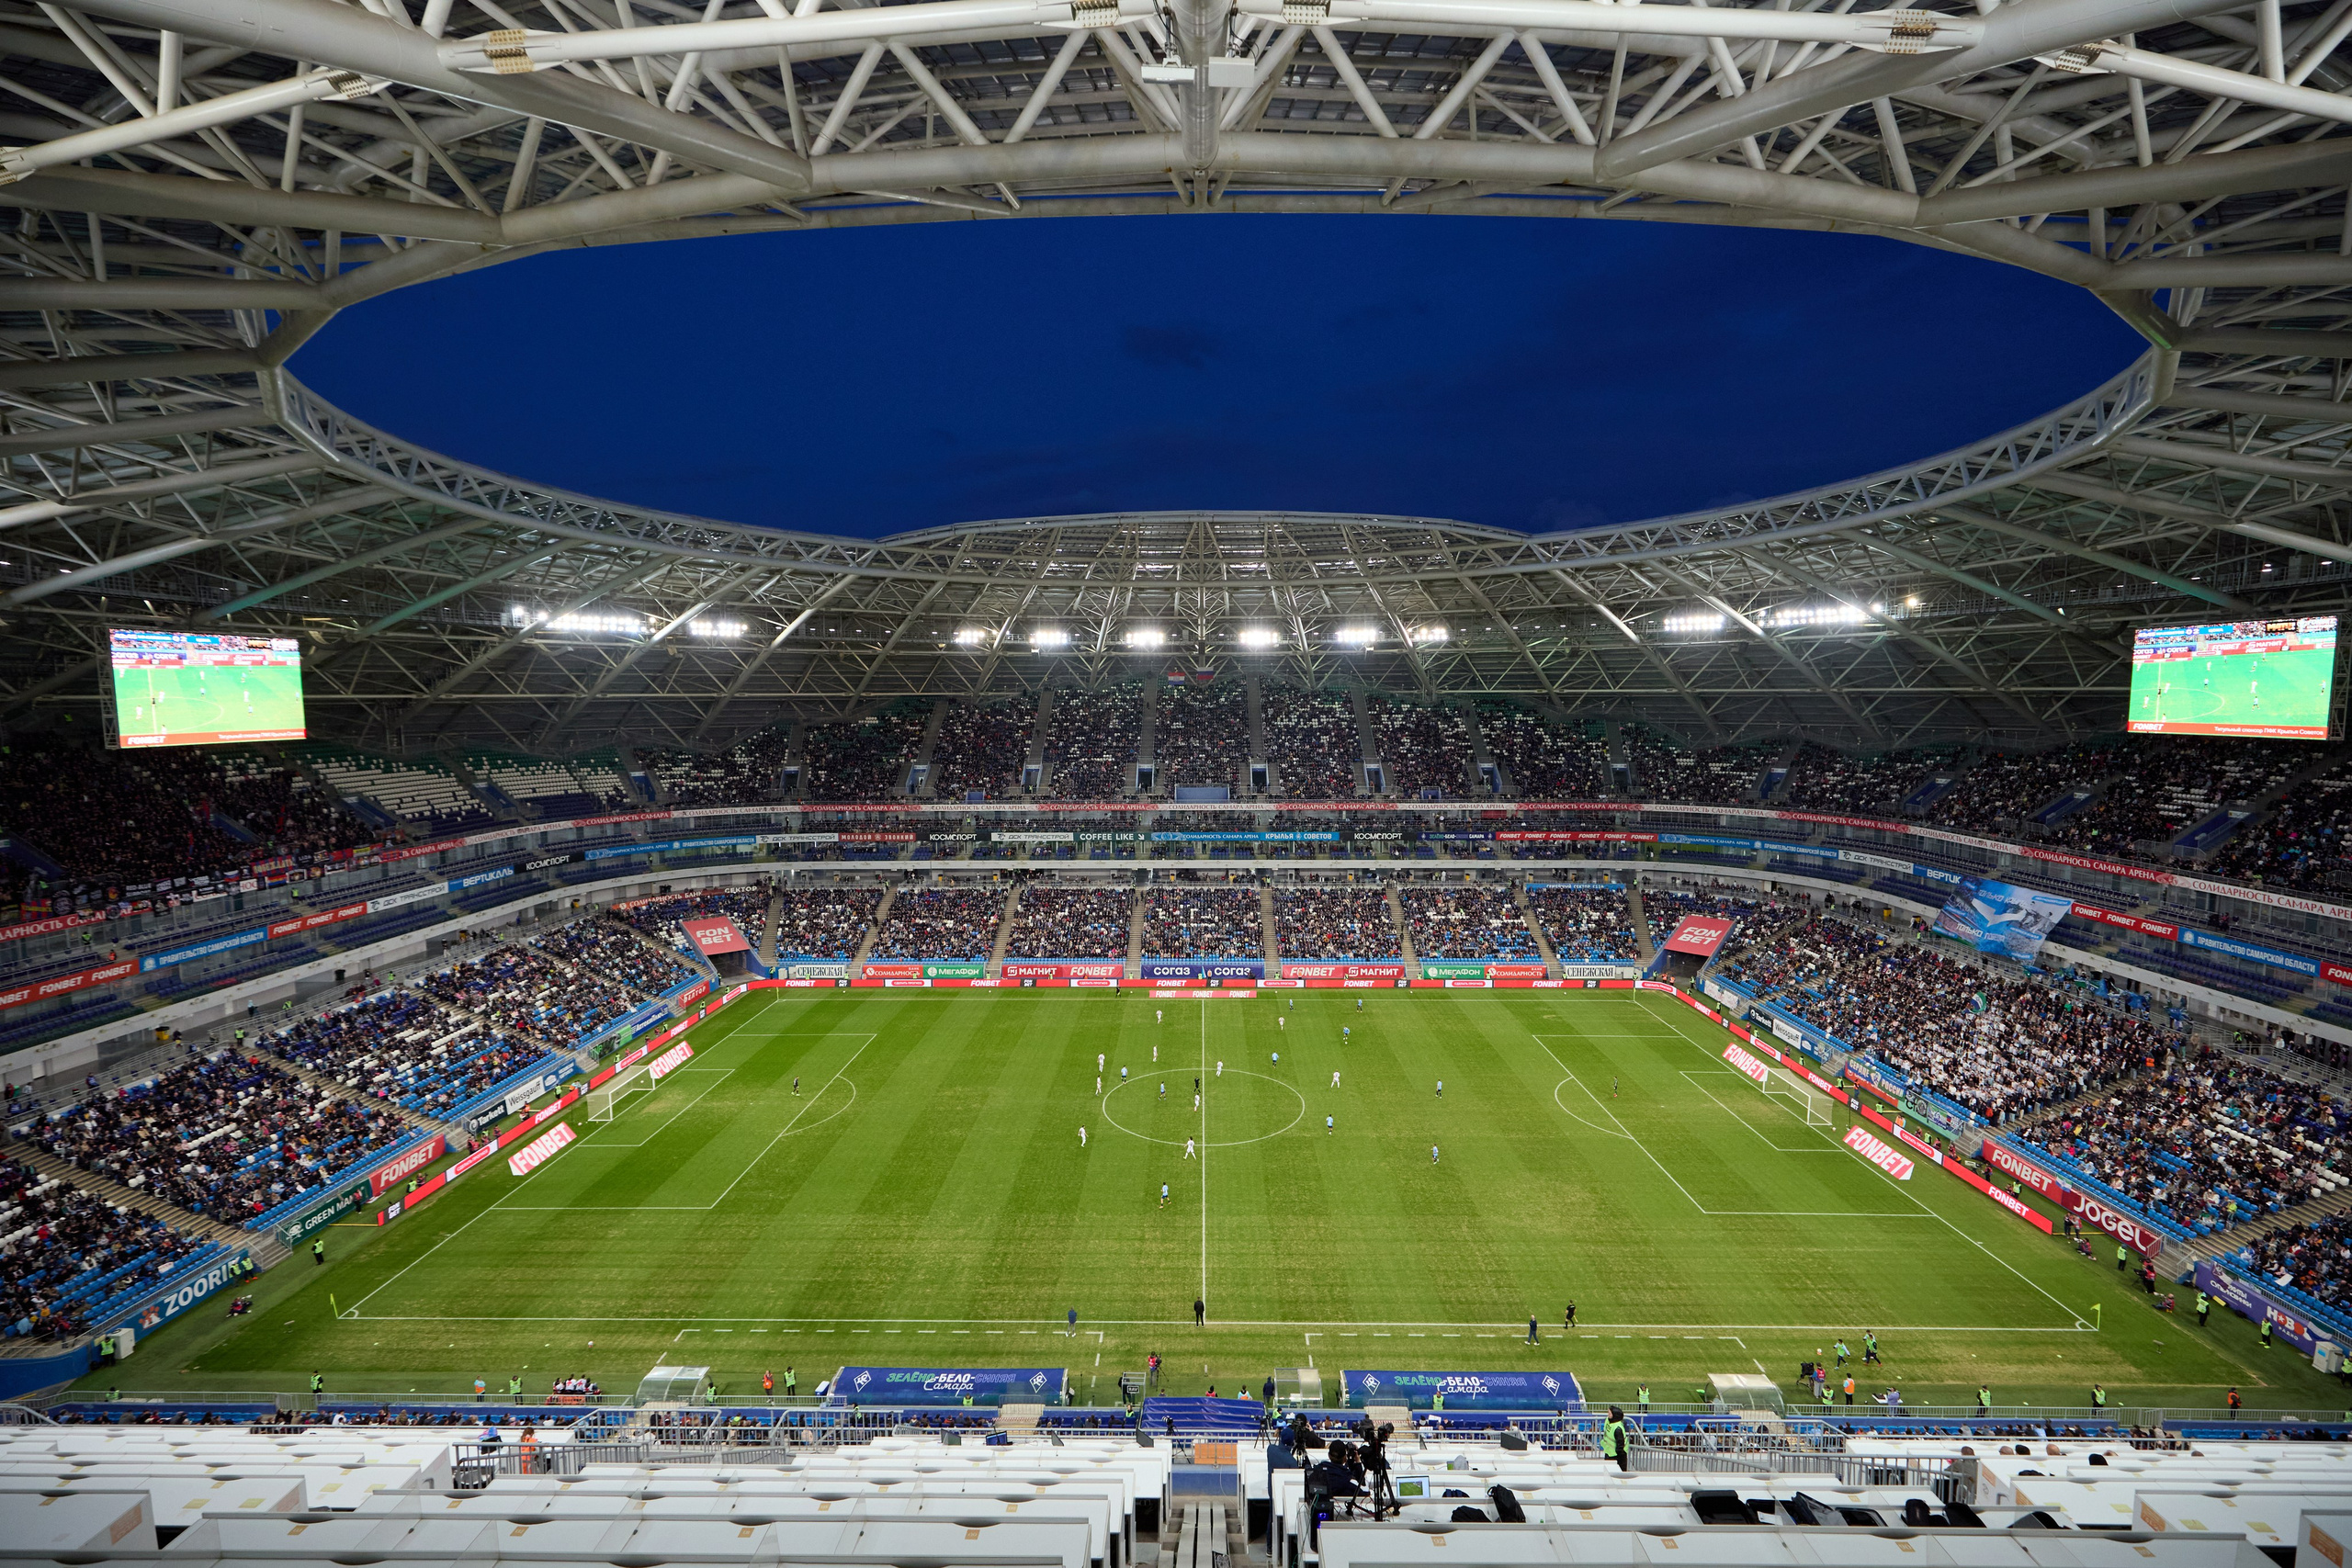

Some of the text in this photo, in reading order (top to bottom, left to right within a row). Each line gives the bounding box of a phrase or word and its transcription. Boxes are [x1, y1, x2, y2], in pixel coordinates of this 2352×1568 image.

[128, 736, 166, 745] FONBET
[586, 811, 669, 826] СОЛИДАРНОСТЬ САМАРА
[683, 807, 737, 817] СОЛИДАРНОСТЬ
[1655, 805, 1710, 814] СОЛИДАРНОСТЬ
[1792, 813, 1847, 825] СОЛИДАРНОСТЬ
[1849, 818, 1875, 828] САМАРА
[475, 829, 515, 842] СОЛИДАРНОСТЬ
[1919, 829, 1962, 844] СОЛИДАРНОСТЬ
[1990, 842, 2008, 852] АРЕНА
[411, 841, 454, 856] САМАРА АРЕНА
[1870, 857, 1912, 871] ТРАНССТРОЙ
[2034, 851, 2154, 880] СОЛИДАРНОСТЬ САМАРА АРЕНА
[463, 867, 514, 887] ВЕРТИКАЛЬ
[400, 885, 446, 900] ТРАНССТРОЙ
[2193, 881, 2274, 904] СОЛИДАРНОСТЬ
[2277, 897, 2324, 914] САМАРА
[274, 905, 364, 934] FONBET FONBET FONBET
[2075, 907, 2173, 936] FONBET FONBET FONBET
[695, 926, 729, 938] FON
[1683, 927, 1722, 937] FON
[1956, 922, 1984, 937] ТОЛЬКО
[701, 933, 733, 945] BET
[1678, 934, 1717, 945] BET
[2198, 937, 2316, 973] ПРАВИТЕЛЬСТВО САМАРСКОЙ ОБЛАСТИ
[40, 964, 132, 995] FONBET FONBET
[797, 966, 842, 976] СЕНЕЖСКАЯ
[1070, 967, 1114, 976] FONBET
[1214, 967, 1250, 976] согаз
[1290, 967, 1335, 976] FONBET
[1361, 967, 1398, 976] МАГНИТ
[1567, 967, 1614, 977] СЕНЕЖСКАЯ
[1695, 1001, 1711, 1016] FONBET
[1755, 1010, 1772, 1028] Tarkett
[670, 1021, 688, 1037] FONBET
[1775, 1021, 1801, 1043] Weissgauff
[653, 1044, 691, 1076] FONBET
[1724, 1045, 1769, 1082] FONBET
[1808, 1073, 1832, 1092] FONBET
[1849, 1058, 1871, 1079] СЕРДЦЕ
[1882, 1076, 1905, 1097] РОССИИ
[508, 1082, 541, 1107] Weissgauff
[477, 1105, 504, 1126] Tarkett
[535, 1100, 562, 1124] FONBET
[514, 1124, 572, 1175] FONBET
[1845, 1127, 1911, 1176] FONBET
[379, 1143, 435, 1188] FONBET
[1992, 1148, 2052, 1191] FONBET
[1988, 1186, 2030, 1216] FONBET
[305, 1206, 335, 1230] GREEN
[164, 1256, 241, 1316] ZOORI
[923, 1378, 974, 1396] Самара
